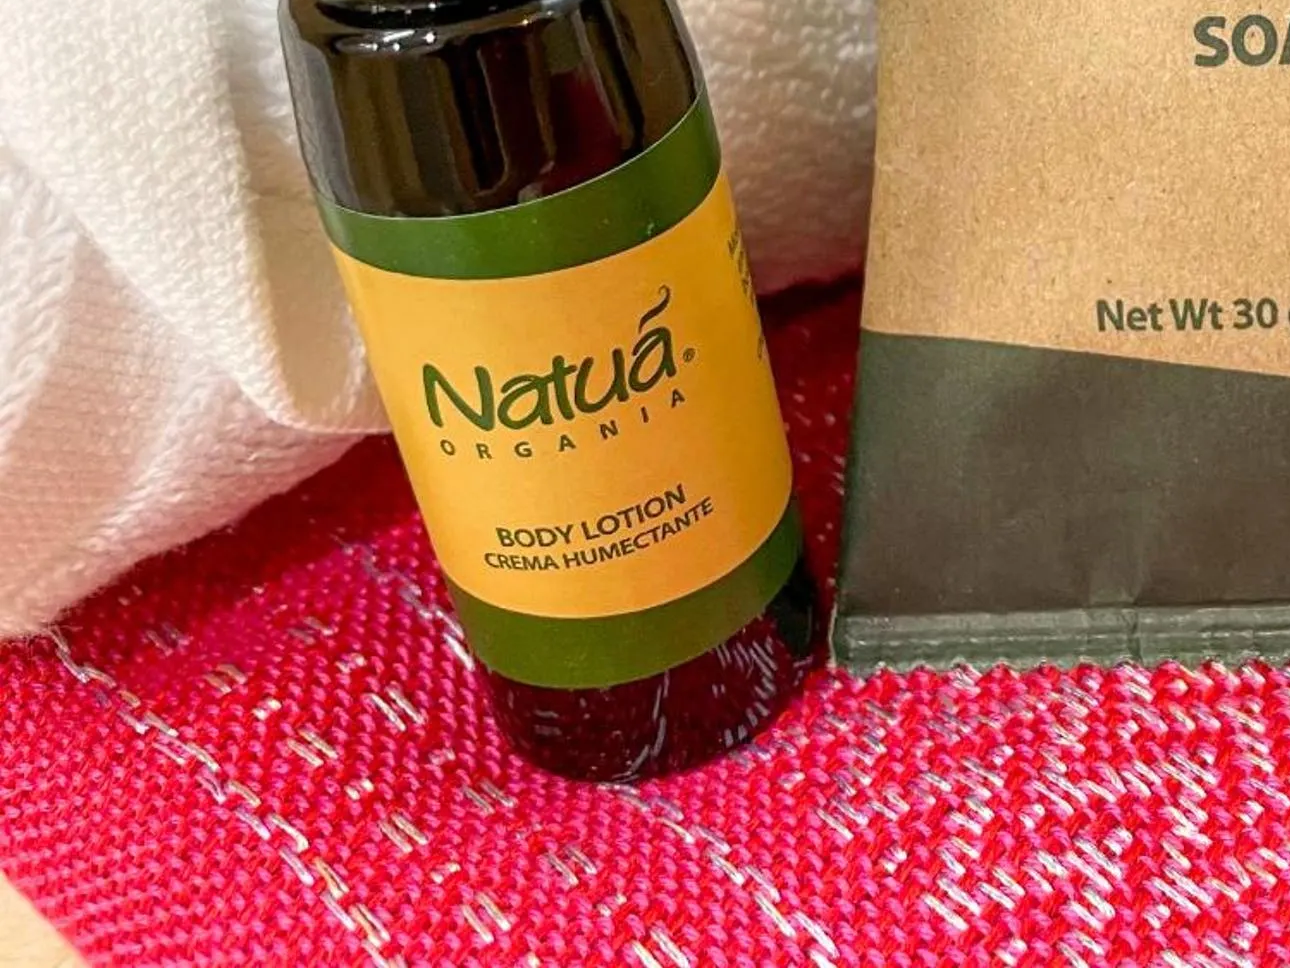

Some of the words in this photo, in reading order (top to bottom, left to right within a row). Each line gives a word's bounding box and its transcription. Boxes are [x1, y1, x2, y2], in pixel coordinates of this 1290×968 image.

[1096, 298, 1163, 332] Net
[1168, 297, 1223, 331] Wt
[1233, 298, 1278, 330] 30
[440, 389, 686, 460] ORGANIA
[484, 551, 559, 572] CREMA
[563, 496, 715, 570] HUMECTANTE
[495, 524, 577, 548] BODY
[581, 484, 687, 541] LOTION
